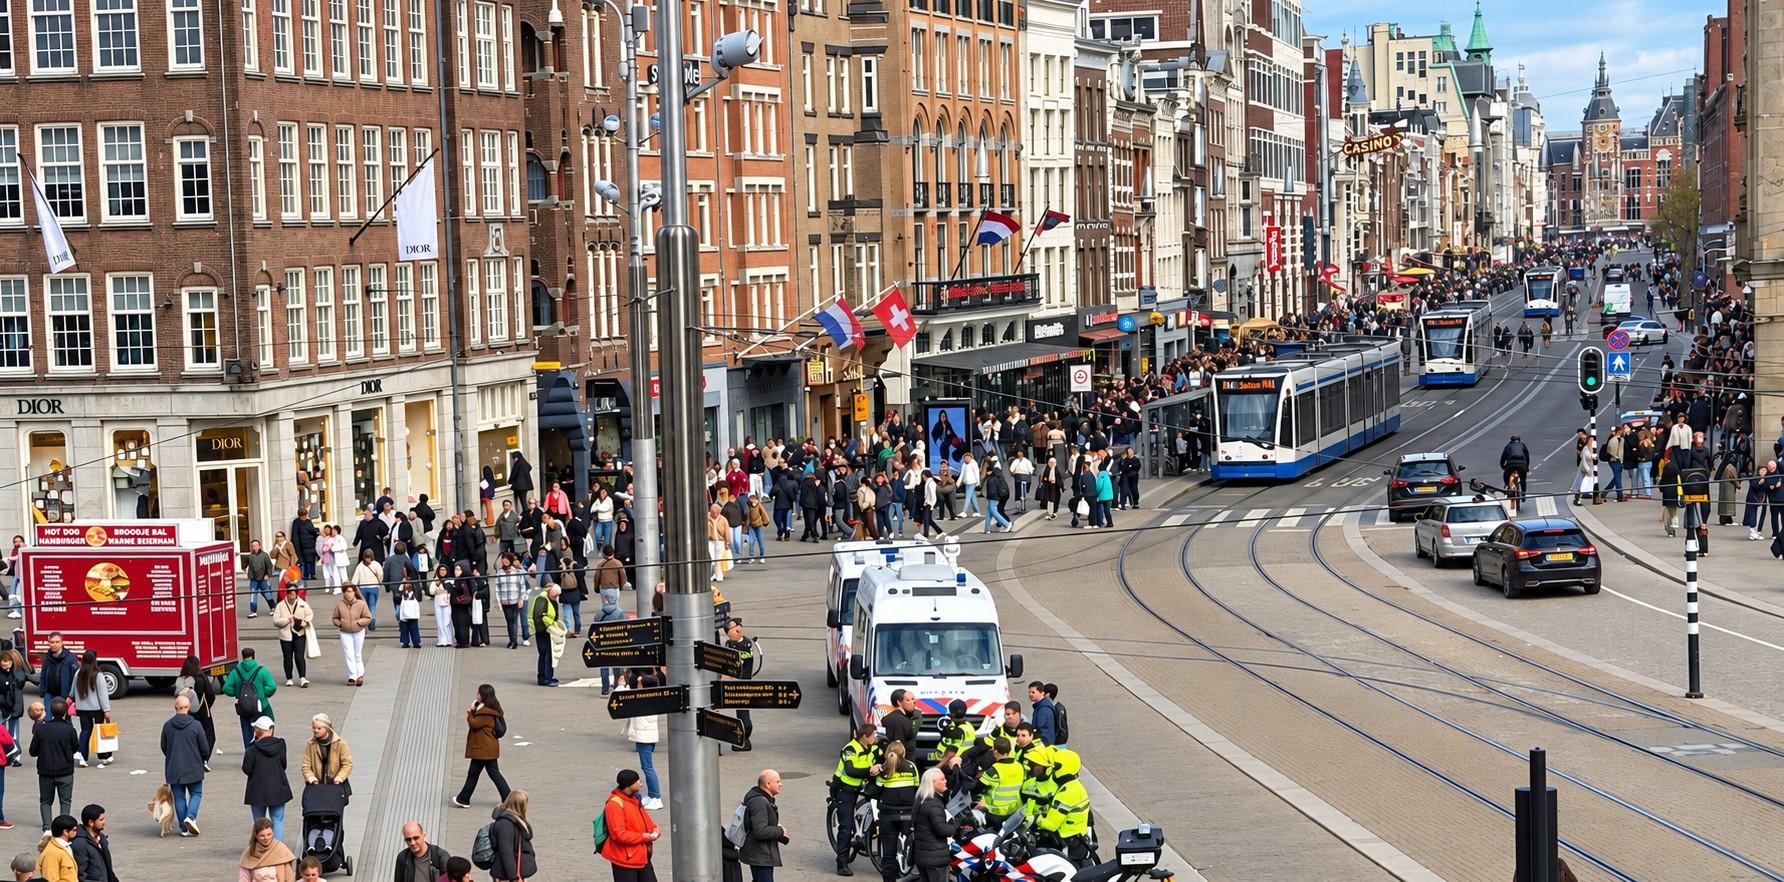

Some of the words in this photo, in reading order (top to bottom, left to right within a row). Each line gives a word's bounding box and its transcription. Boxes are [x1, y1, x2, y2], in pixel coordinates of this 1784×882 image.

[1343, 135, 1392, 154] CASINO
[406, 244, 431, 254] DIOR
[361, 379, 382, 395] DIOR
[17, 399, 64, 414] DIOR
[212, 437, 243, 450] DIOR
[45, 528, 61, 536] HOT
[114, 528, 149, 536] BROODJE
